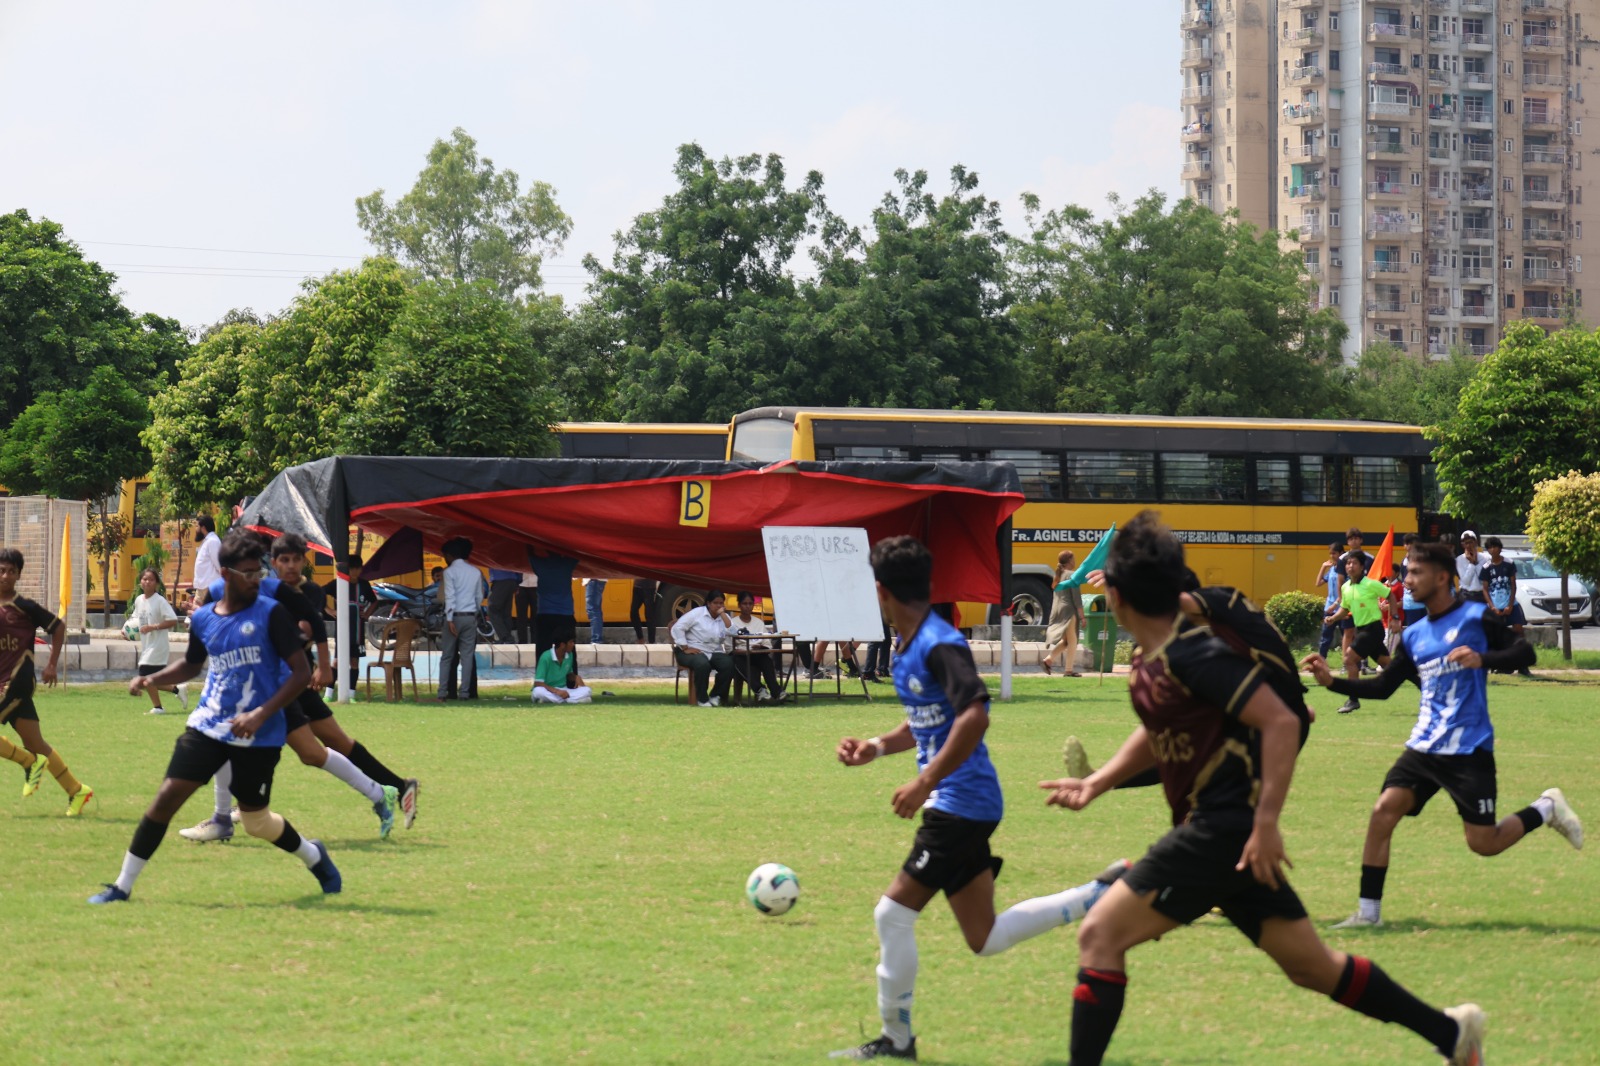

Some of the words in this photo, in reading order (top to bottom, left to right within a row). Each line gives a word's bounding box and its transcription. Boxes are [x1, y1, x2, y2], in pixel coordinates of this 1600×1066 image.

[684, 480, 704, 521] B
[1034, 530, 1075, 541] AGNEL
[915, 849, 930, 869] 3
